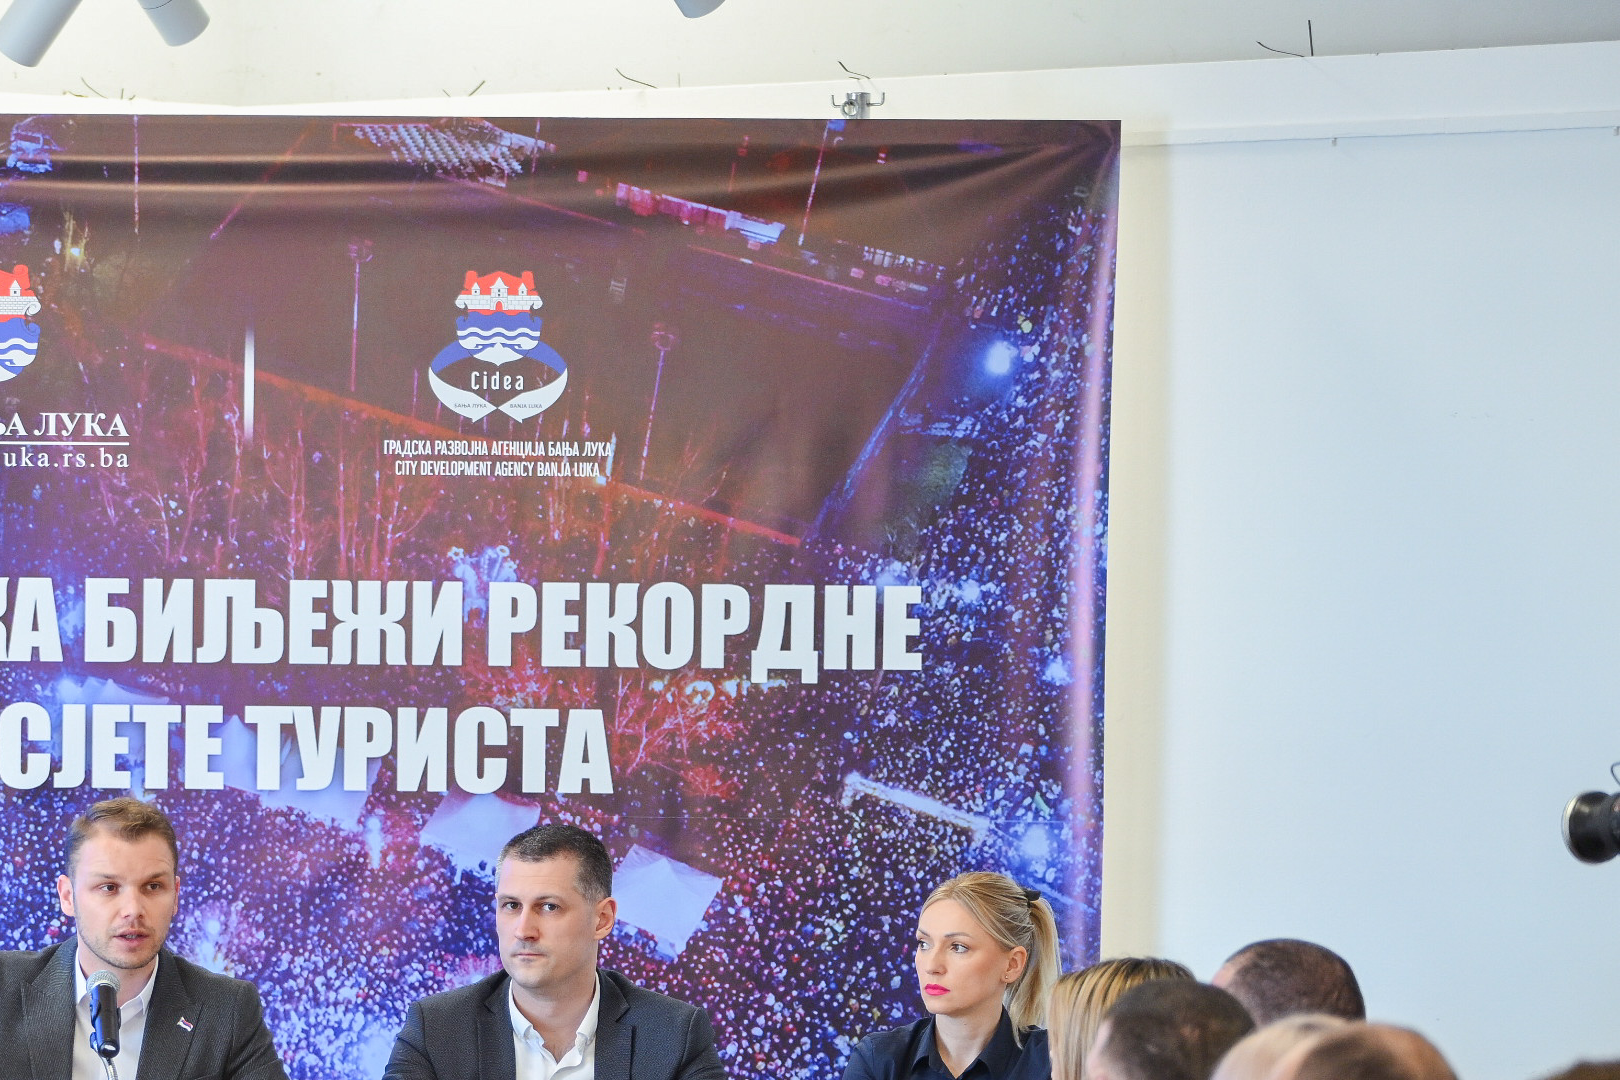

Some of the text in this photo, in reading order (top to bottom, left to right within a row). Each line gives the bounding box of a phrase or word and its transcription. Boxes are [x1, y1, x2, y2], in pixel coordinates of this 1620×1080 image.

[470, 371, 525, 391] Cidea
[33, 412, 130, 438] ЛУКА
[383, 439, 612, 459] ГРАДСКА РАЗВОЈНА АГЕНЦИЈА БАЊА ЛУКА
[395, 460, 600, 477] CITY DEVELOPMENT AGENCY BANJA LUKA
[83, 576, 465, 667] БИЉЕЖИ
[491, 582, 923, 685] РЕКОРДНЕ
[246, 705, 616, 795] ТУРИСТА
